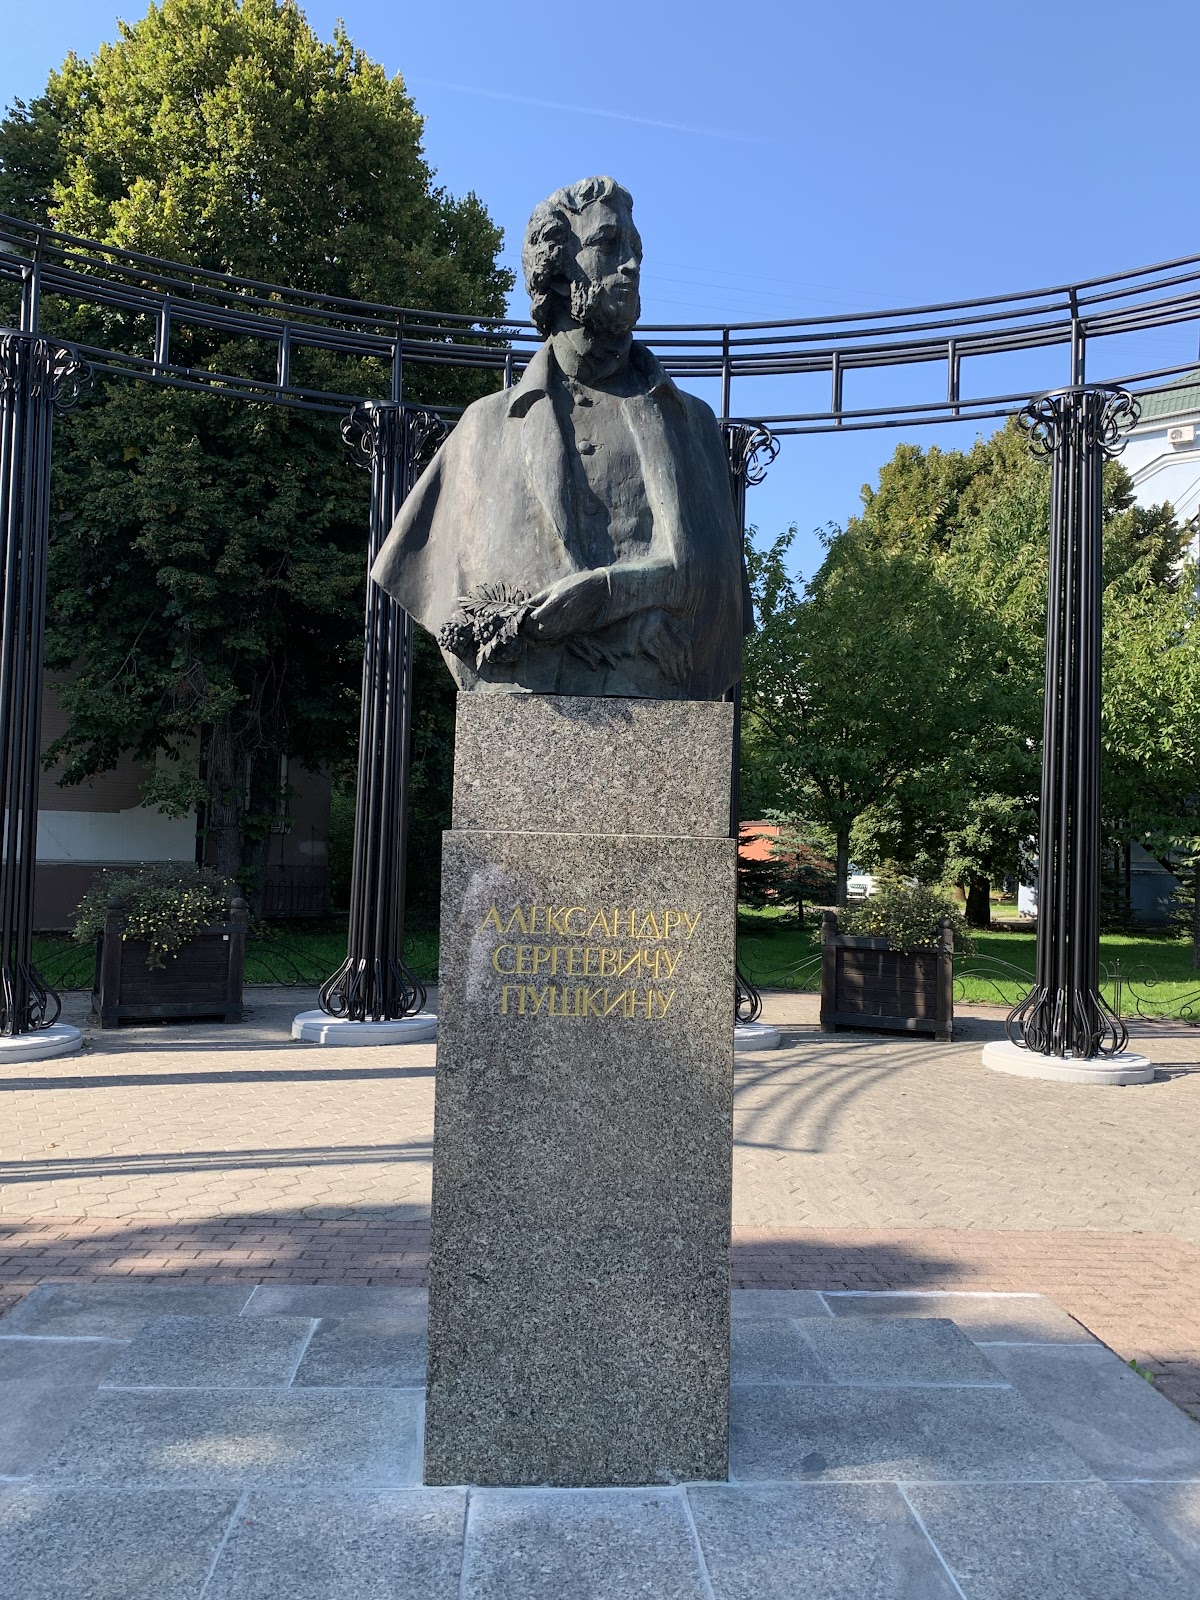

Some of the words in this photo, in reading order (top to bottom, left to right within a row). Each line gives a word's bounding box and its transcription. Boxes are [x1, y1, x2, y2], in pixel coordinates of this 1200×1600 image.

[479, 904, 702, 939] АЛЕКСАНДРУ
[492, 944, 682, 979] СЕРГЕЕВИЧУ
[501, 985, 676, 1019] ПУШКИНУ
